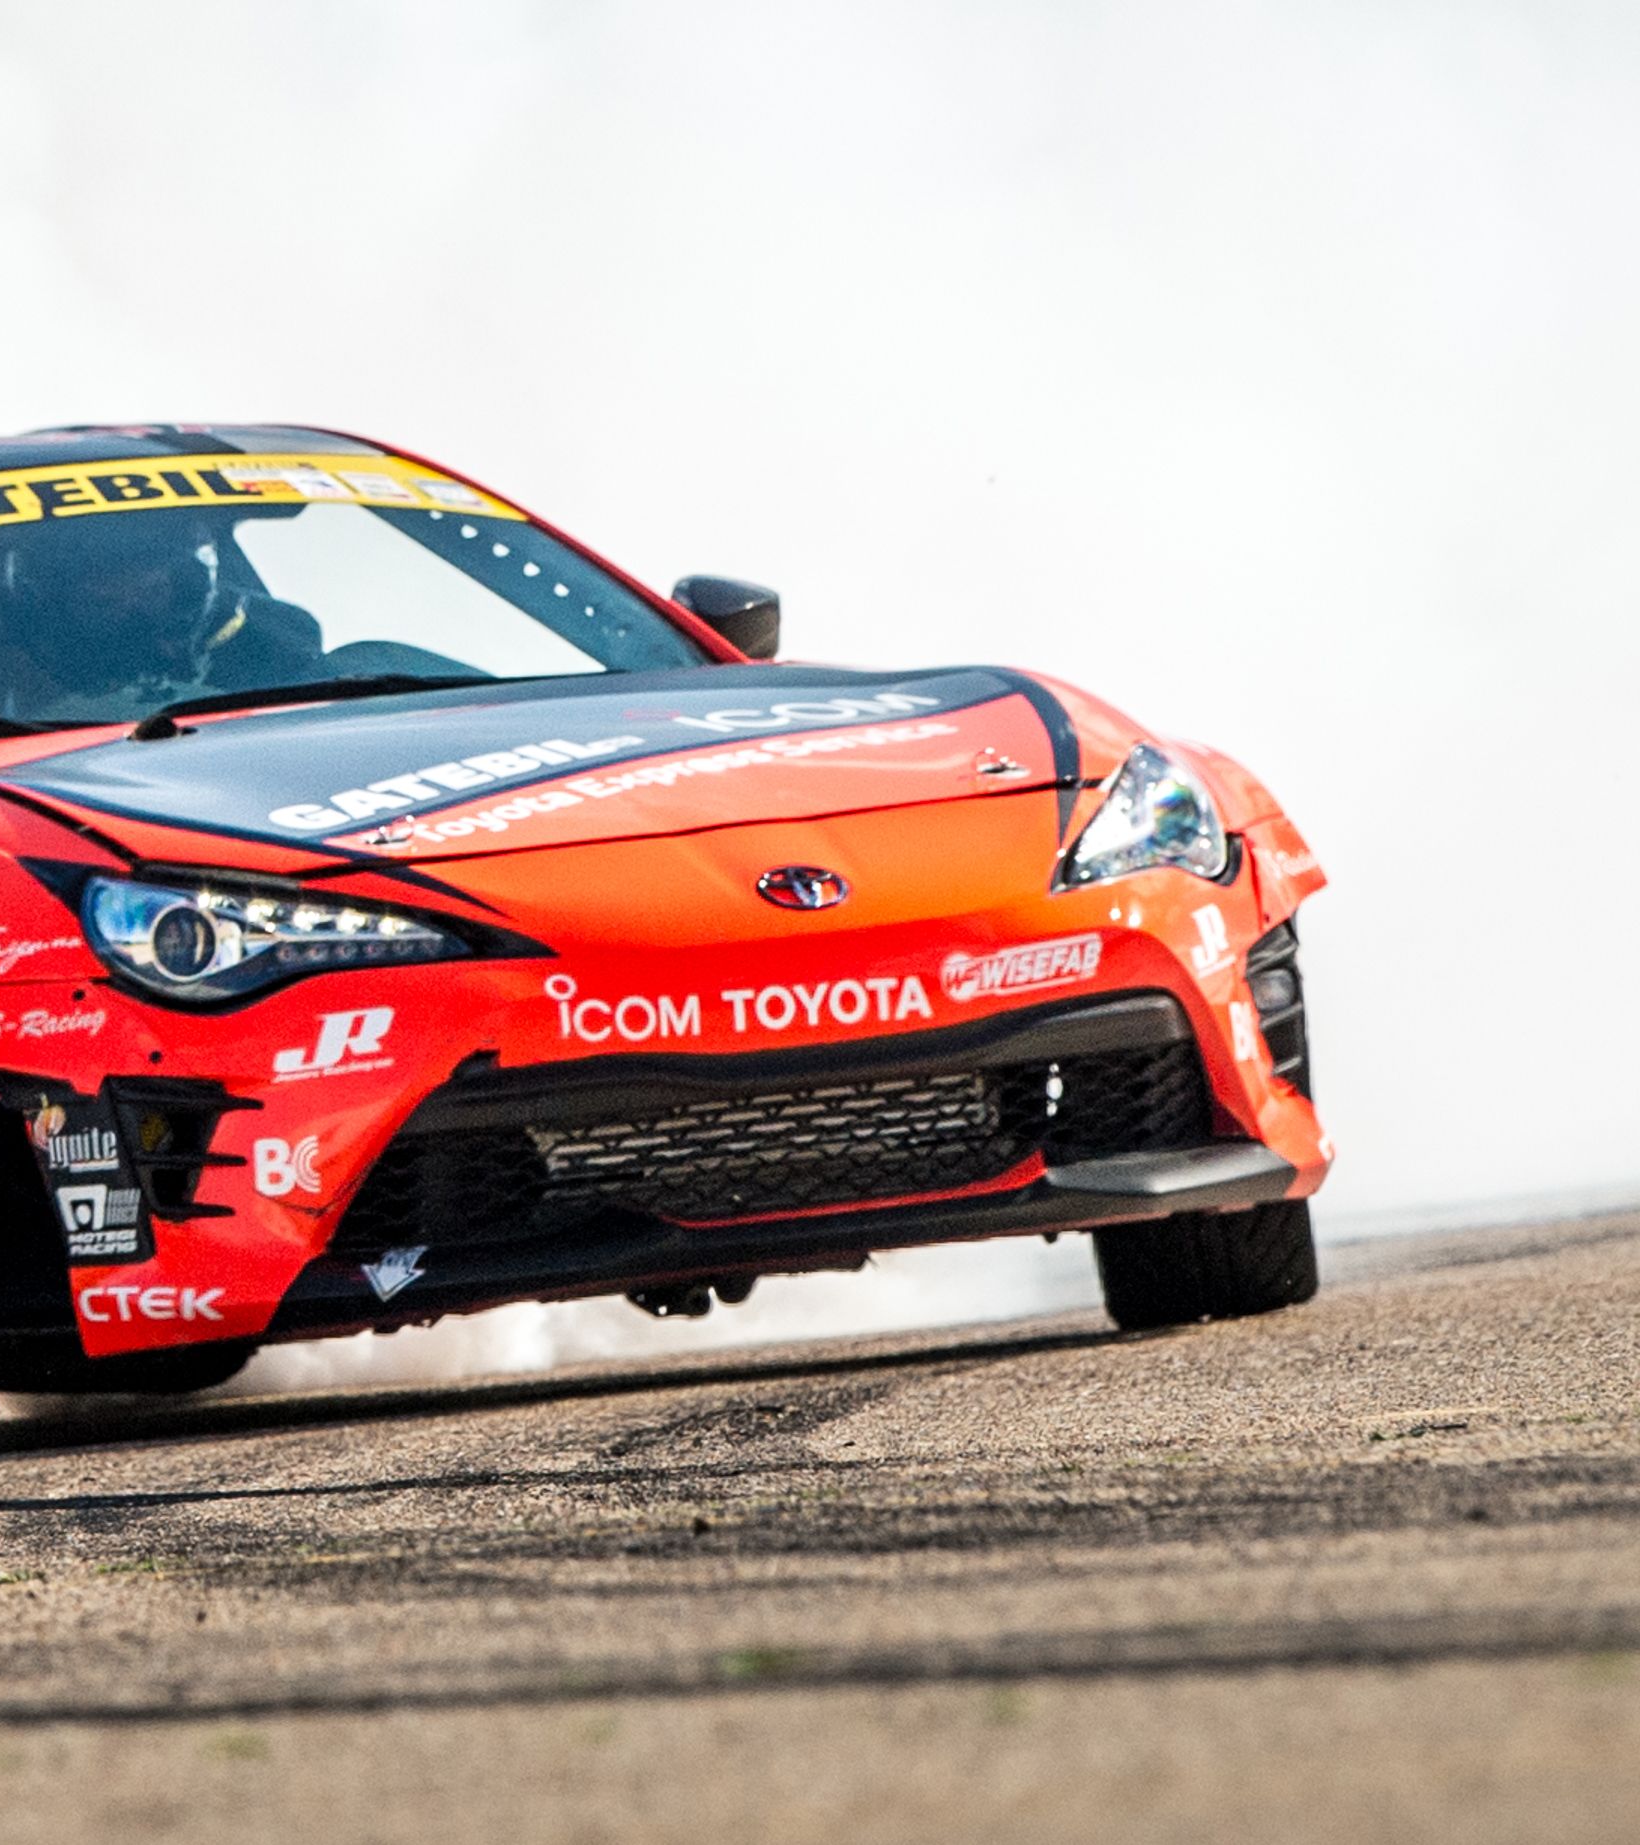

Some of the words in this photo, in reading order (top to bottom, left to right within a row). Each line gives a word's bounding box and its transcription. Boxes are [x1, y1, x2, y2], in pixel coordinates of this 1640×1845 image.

[410, 786, 584, 844] Toyota
[566, 748, 774, 799] Express
[758, 721, 960, 758] Service
[980, 941, 1103, 990] WISEFAB
[721, 977, 933, 1032] TOYOTA
[273, 1006, 395, 1073] JR
[47, 1127, 118, 1168] ignite
[254, 1135, 322, 1197] BC
[79, 1285, 226, 1323] CTEK
